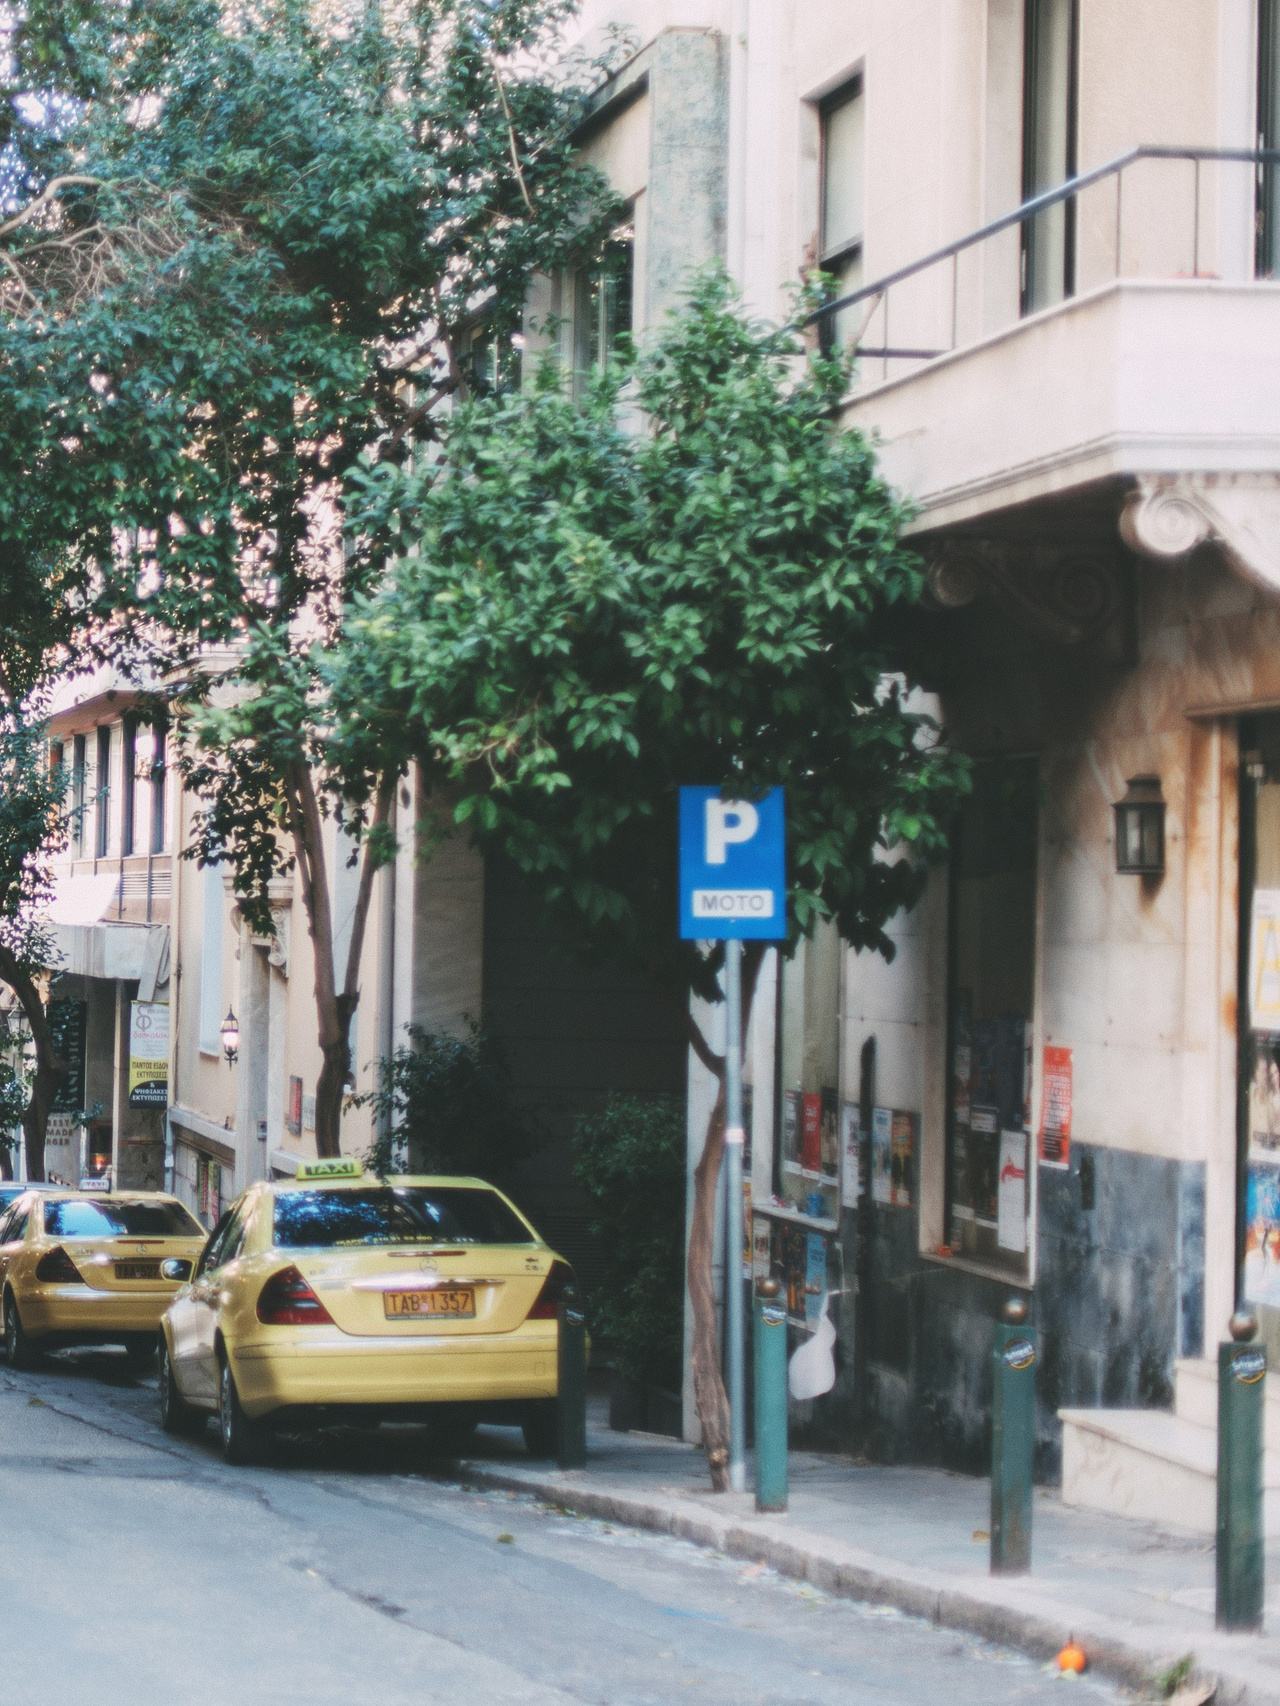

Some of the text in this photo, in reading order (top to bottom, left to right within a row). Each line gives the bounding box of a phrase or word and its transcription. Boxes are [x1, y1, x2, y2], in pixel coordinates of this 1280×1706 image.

[705, 799, 759, 864] P
[702, 895, 765, 911] MOTO
[308, 1163, 353, 1175] TAXI
[389, 1292, 470, 1312] TAB 1357
